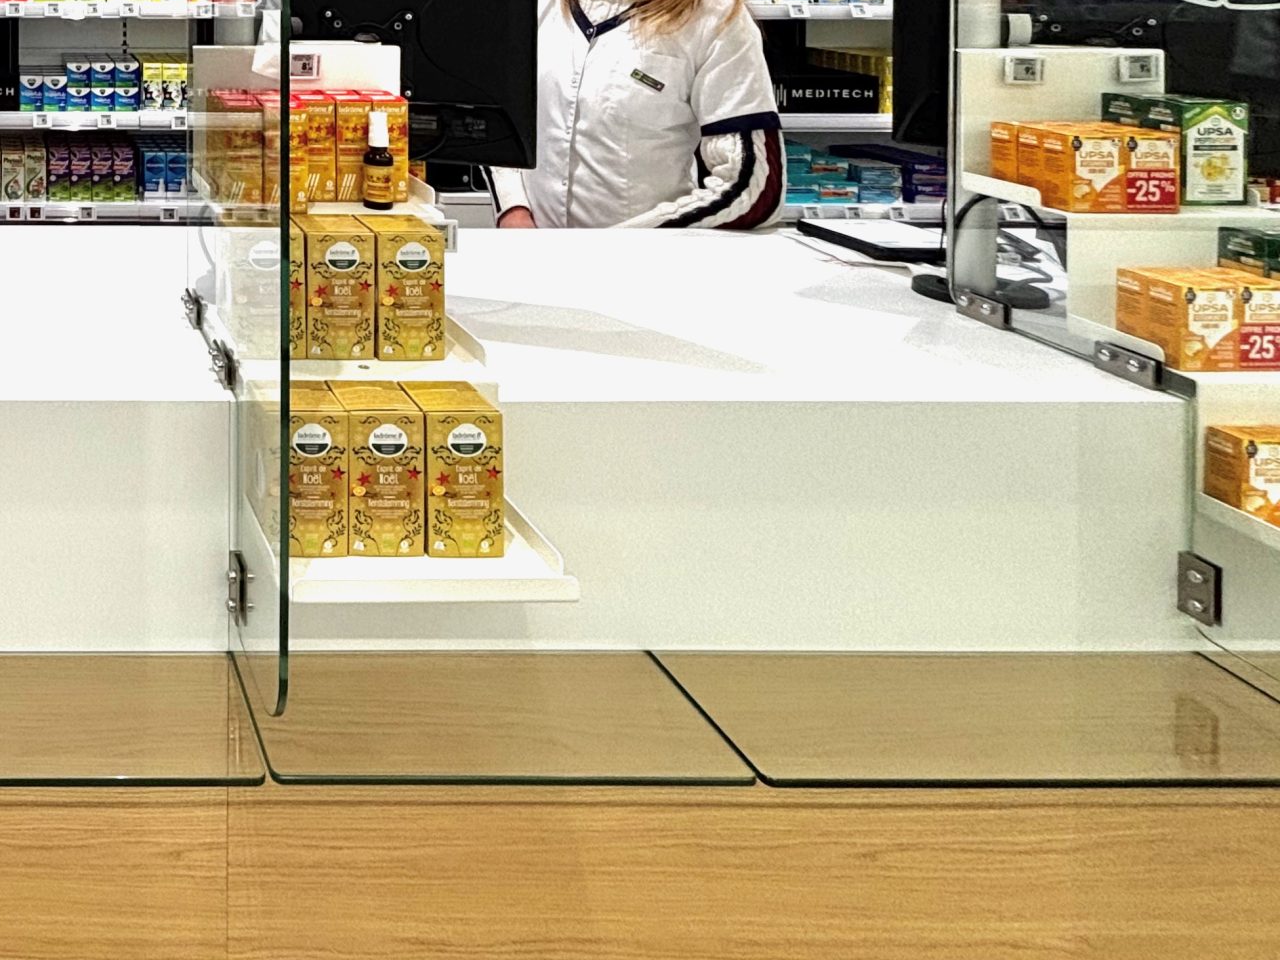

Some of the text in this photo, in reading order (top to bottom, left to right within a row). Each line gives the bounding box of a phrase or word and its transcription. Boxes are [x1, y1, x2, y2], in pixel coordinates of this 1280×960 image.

[791, 89, 874, 99] MEDITECH
[1197, 127, 1234, 136] UPSA
[1079, 151, 1115, 160] UPSA
[1134, 151, 1170, 160] UPSA
